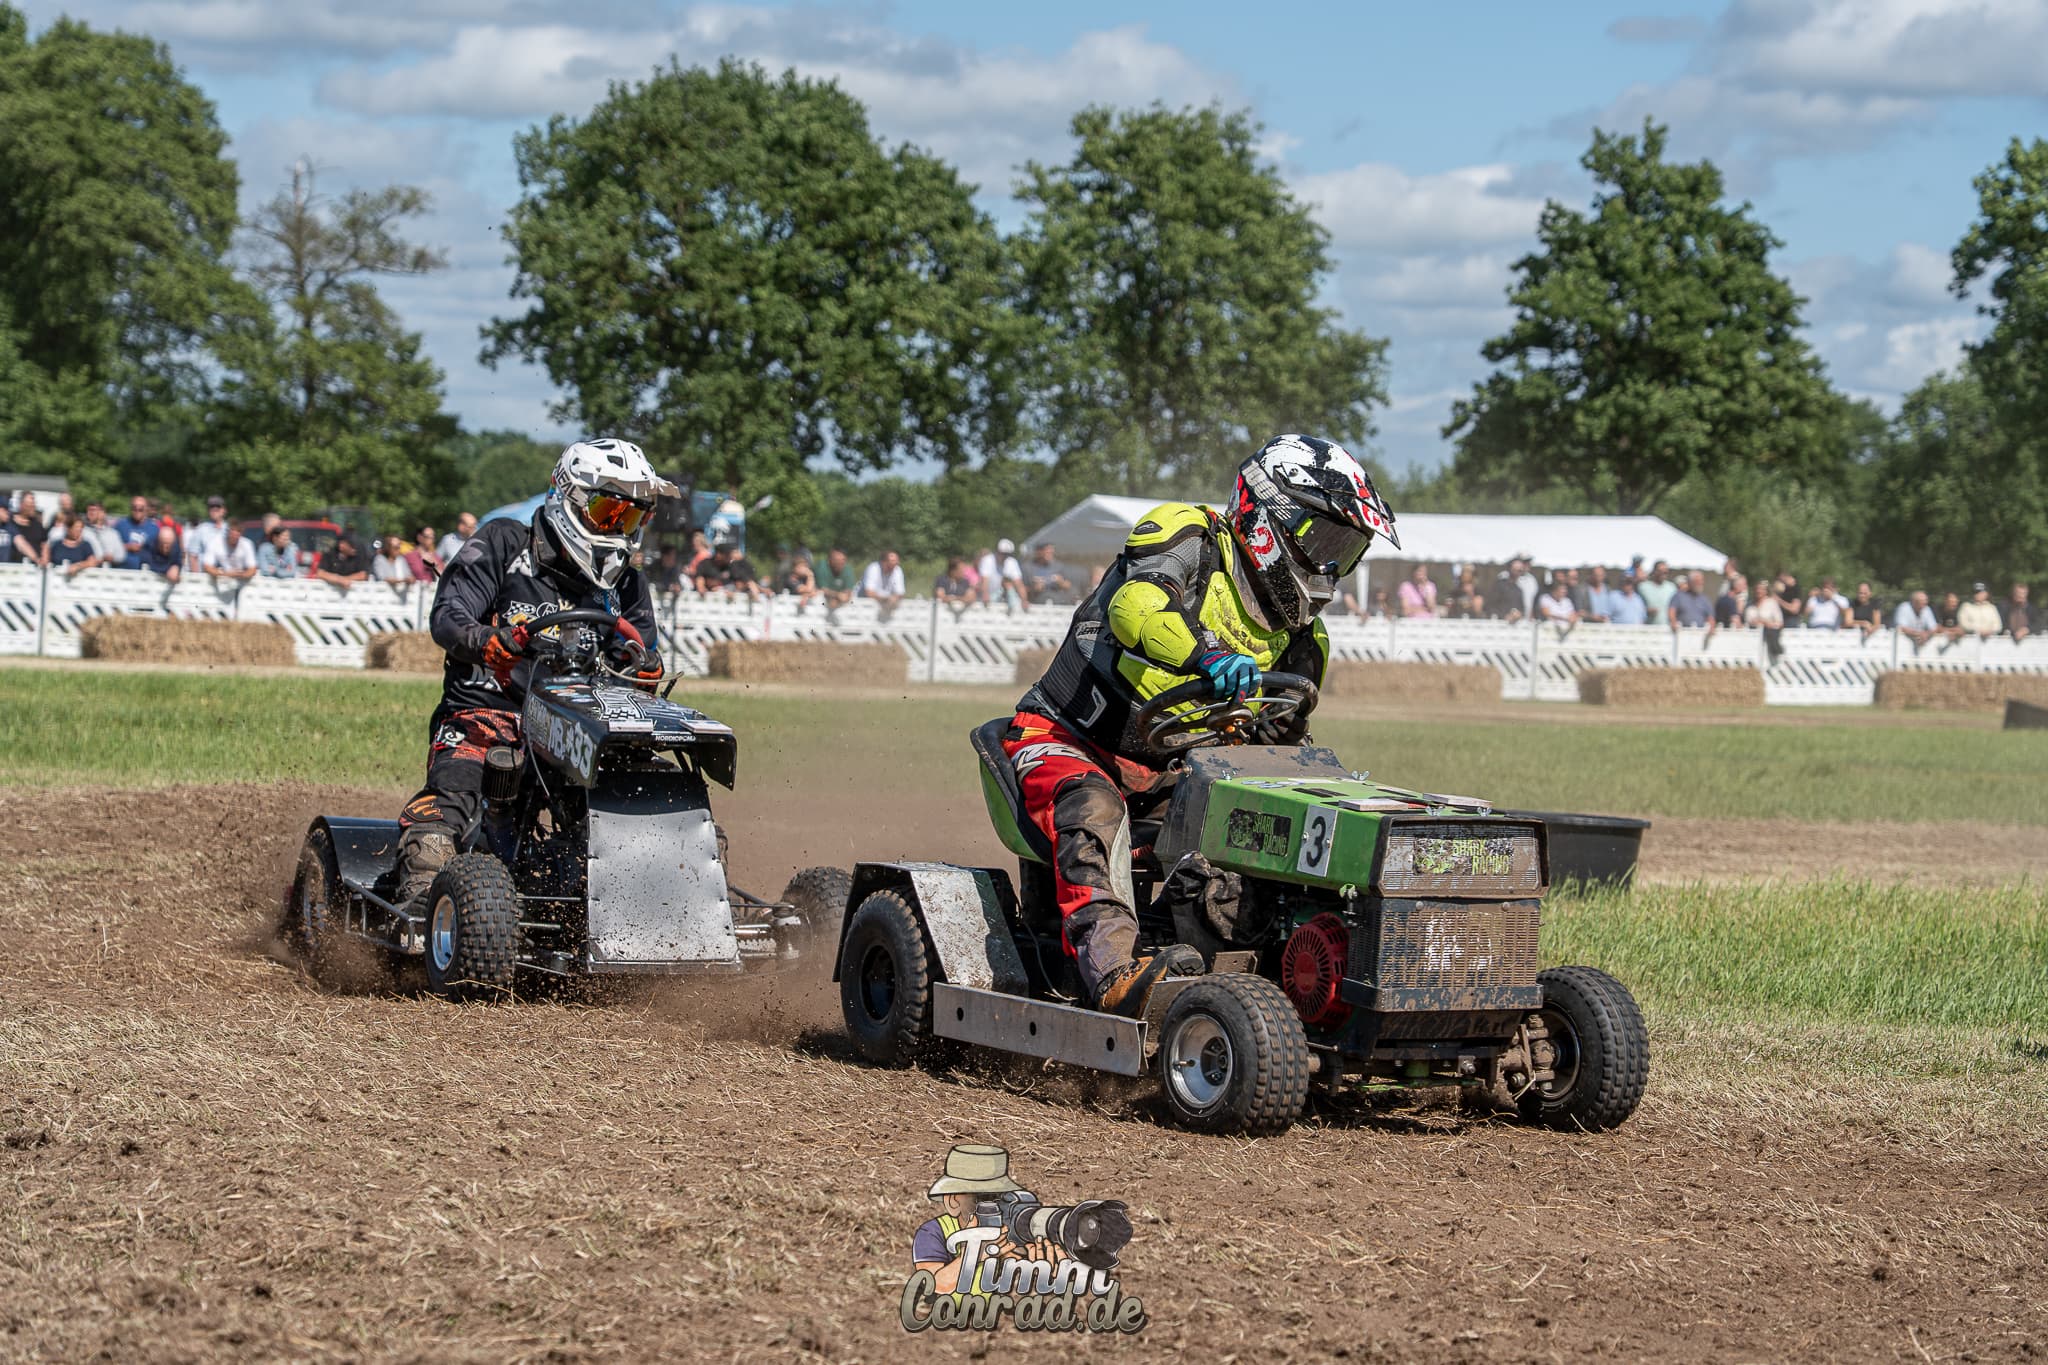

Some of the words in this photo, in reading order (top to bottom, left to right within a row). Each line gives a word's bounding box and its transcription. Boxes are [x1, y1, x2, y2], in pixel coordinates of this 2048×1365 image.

[1253, 814, 1276, 835] SHARK
[1263, 834, 1288, 856] RACING
[1306, 815, 1327, 868] 3
